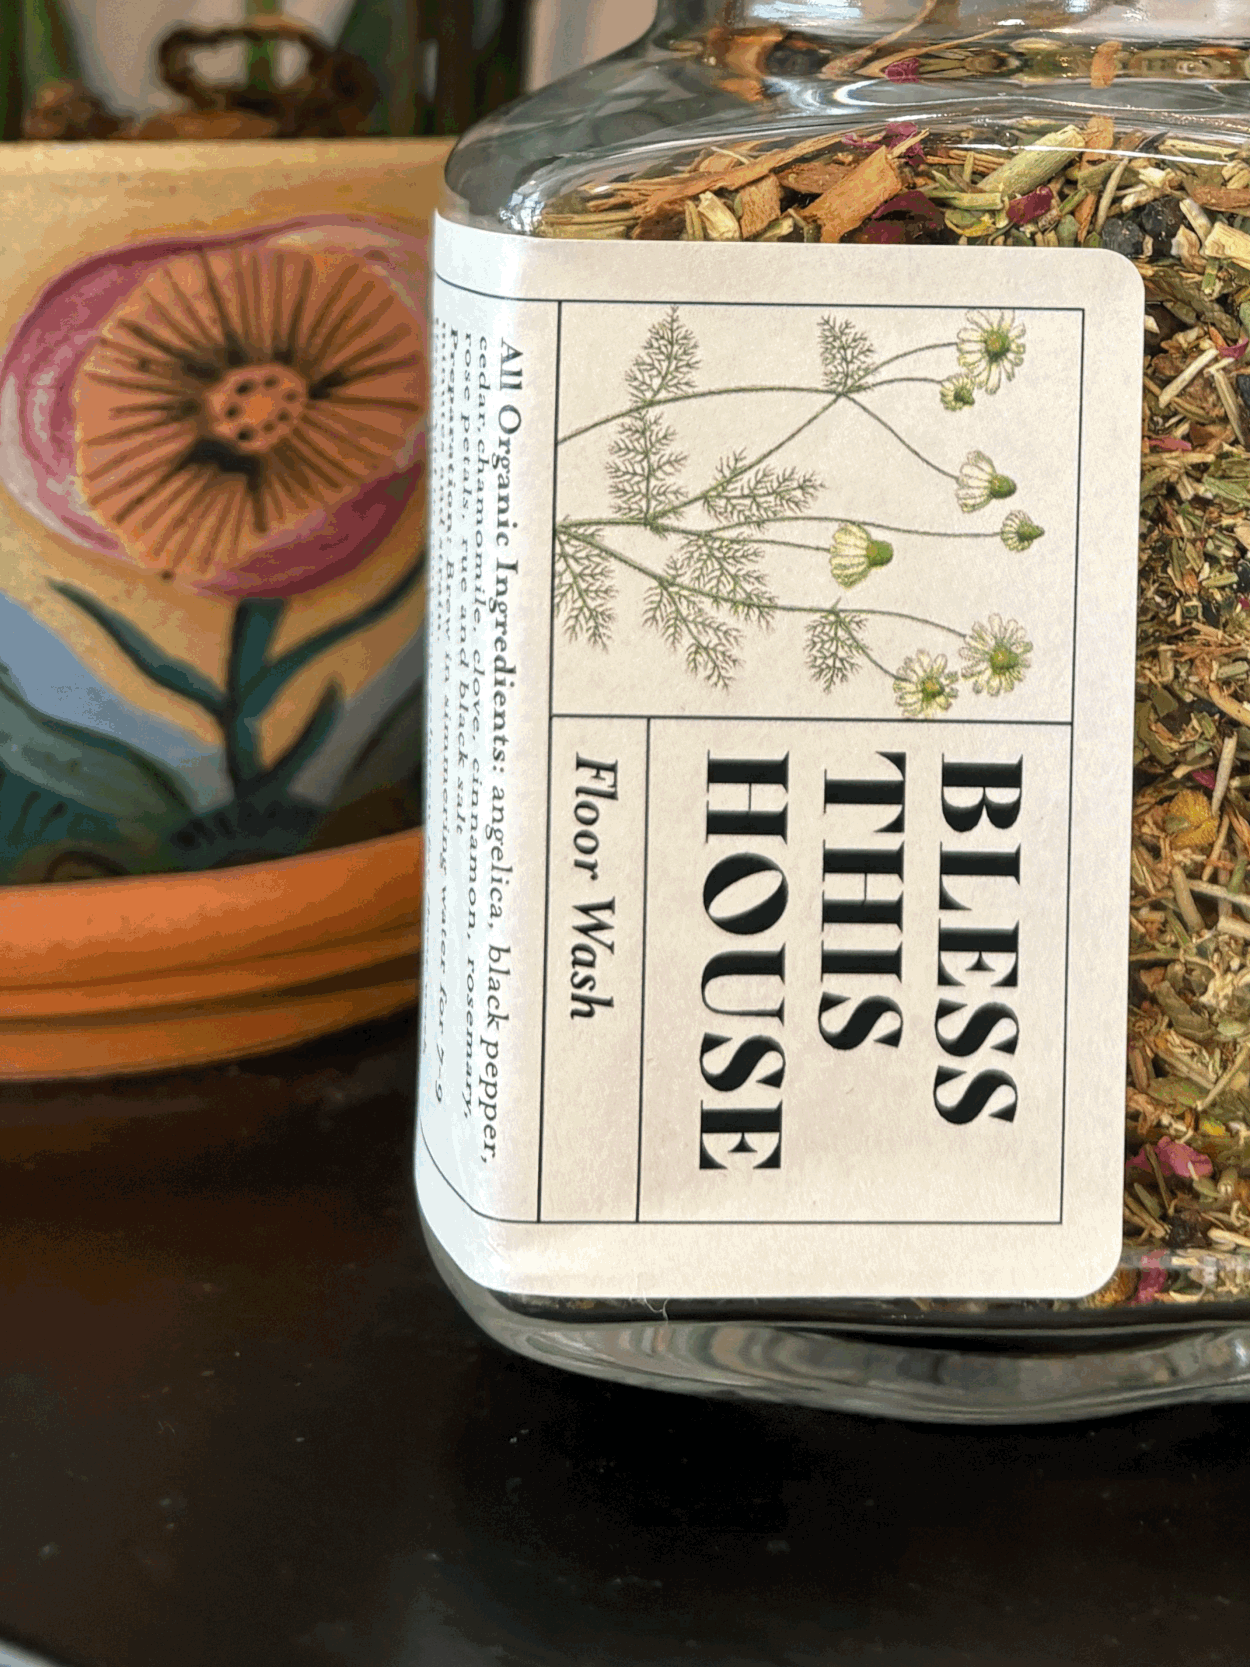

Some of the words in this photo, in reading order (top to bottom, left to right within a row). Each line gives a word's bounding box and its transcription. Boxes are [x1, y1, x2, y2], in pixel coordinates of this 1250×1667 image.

[464, 332, 472, 401] rose
[477, 336, 491, 433] cedar,
[500, 337, 524, 391] All
[447, 325, 459, 544] Preparation:
[461, 412, 472, 519] petals,
[492, 404, 522, 547] Organic
[460, 537, 469, 592] rue
[473, 439, 490, 632] chamomile,
[445, 558, 455, 641] Brew
[460, 604, 470, 668] and
[444, 651, 452, 683] in
[458, 680, 470, 768] black
[472, 649, 486, 741] clove,
[489, 557, 519, 772] Ingredients:
[440, 695, 452, 876] simmering
[456, 776, 466, 834] salt
[573, 751, 618, 881] Floor
[466, 757, 483, 940] cinnamon,
[485, 785, 513, 928] angelica,
[818, 750, 906, 1050] THIS
[487, 944, 511, 1030] black
[570, 896, 616, 1021] Wash
[699, 749, 789, 1169] HOUSE
[933, 753, 1023, 1125] BLESS
[439, 982, 448, 1035] for
[462, 956, 475, 1119] rosemary,
[479, 1035, 499, 1164] pepper,
